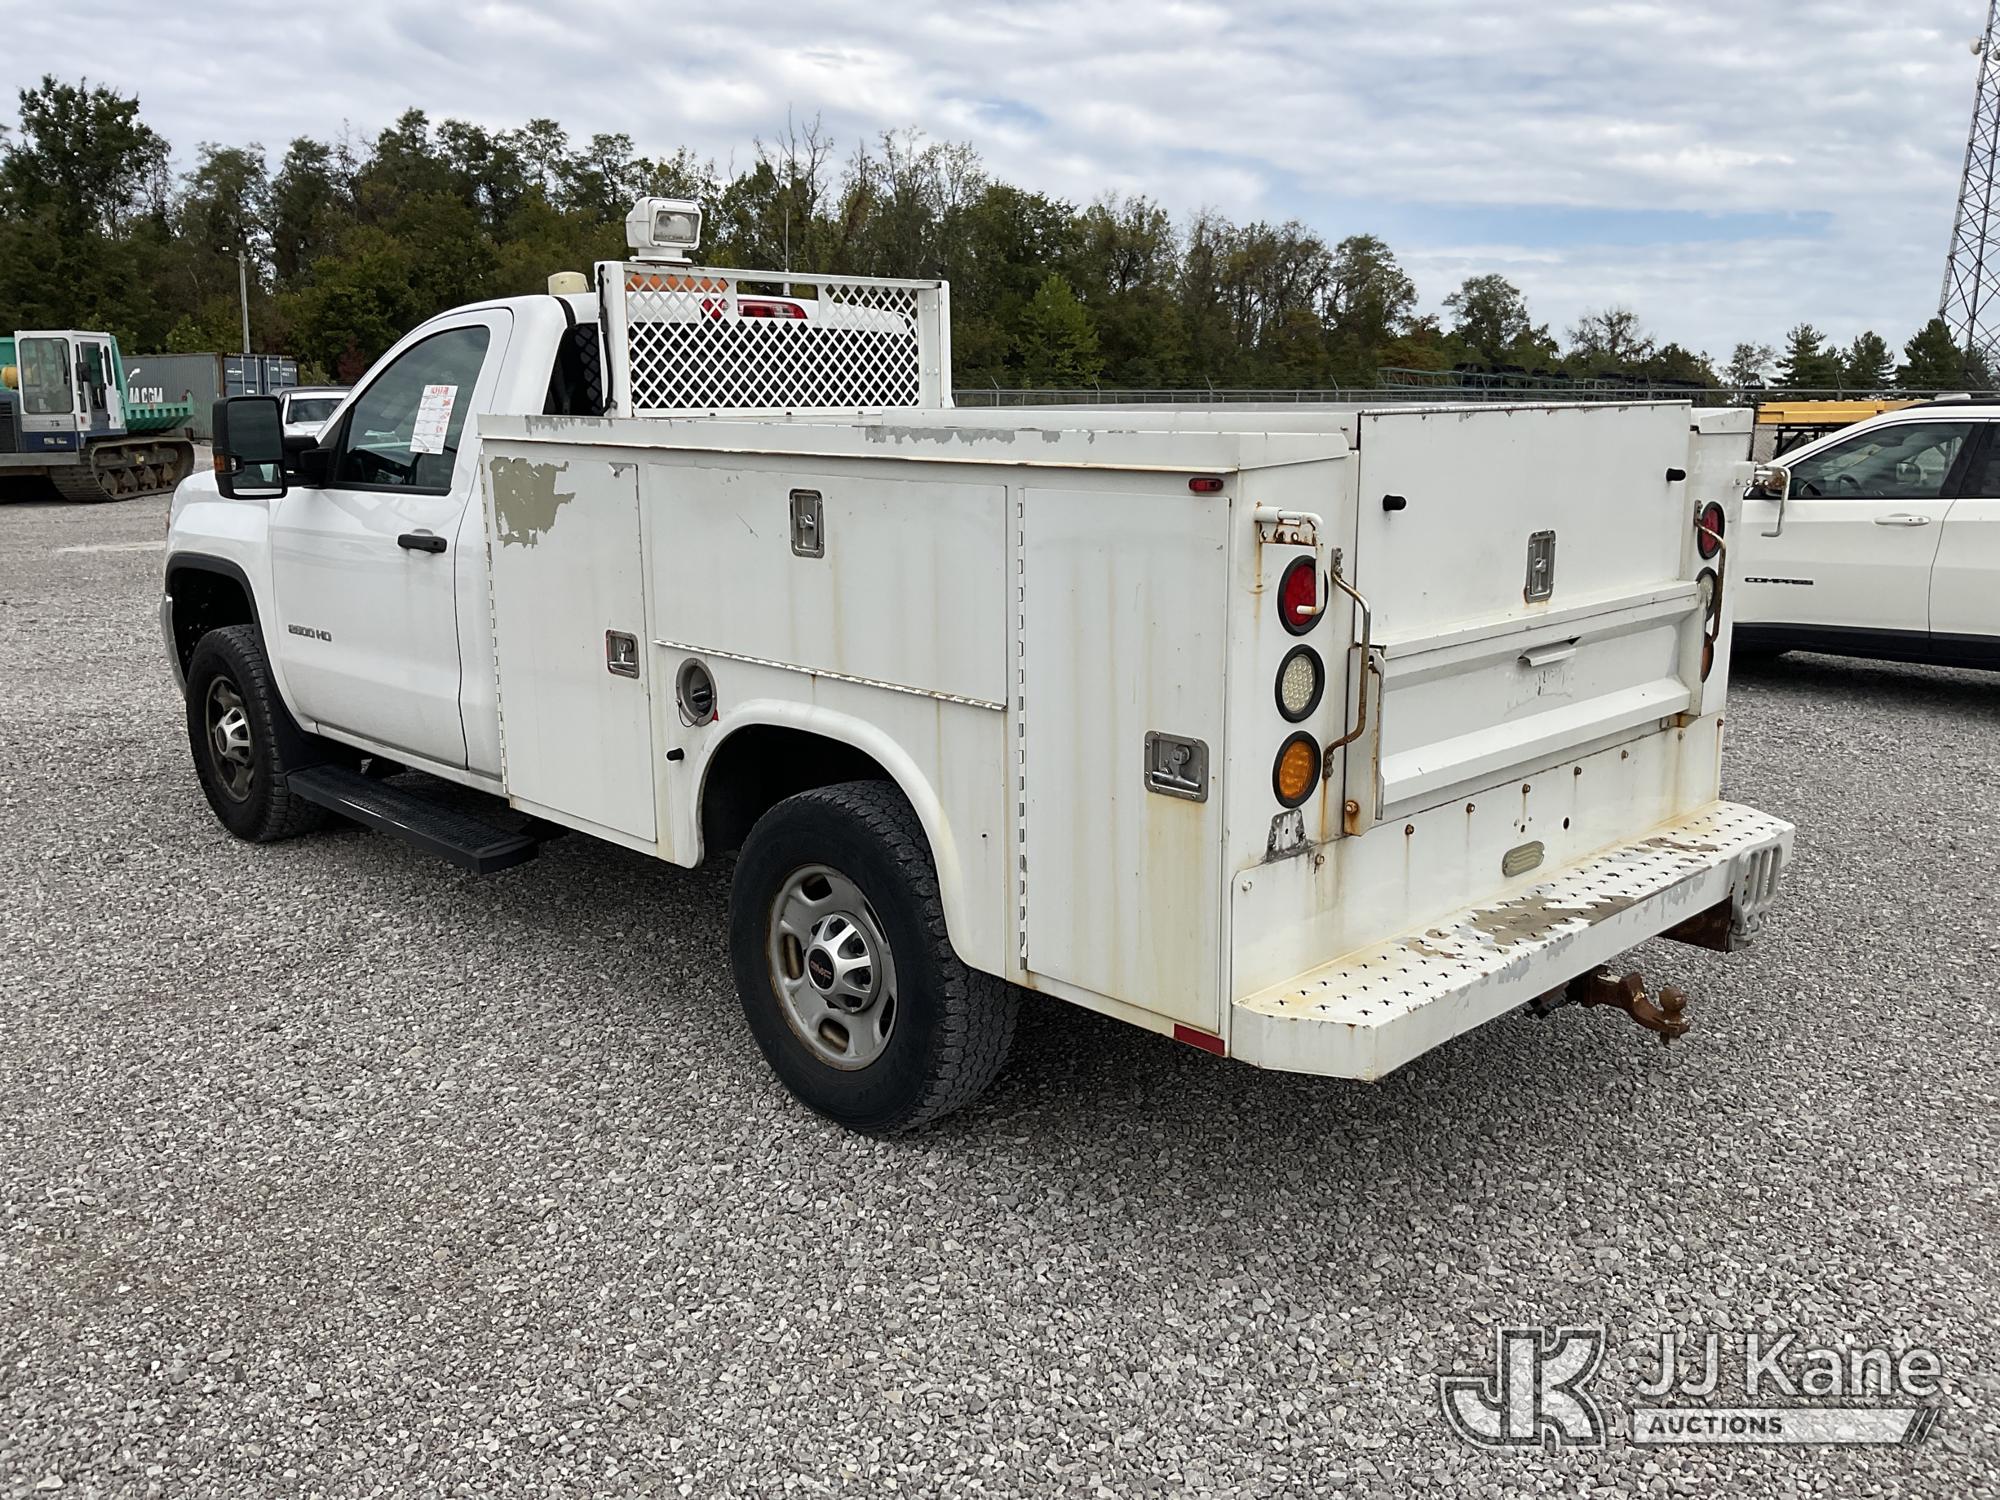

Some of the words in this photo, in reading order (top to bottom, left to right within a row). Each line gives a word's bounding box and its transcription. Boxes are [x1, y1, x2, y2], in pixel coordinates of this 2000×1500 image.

[1744, 577, 1814, 585] COMPASS
[316, 629, 332, 642] HD
[810, 960, 832, 979] GMC
